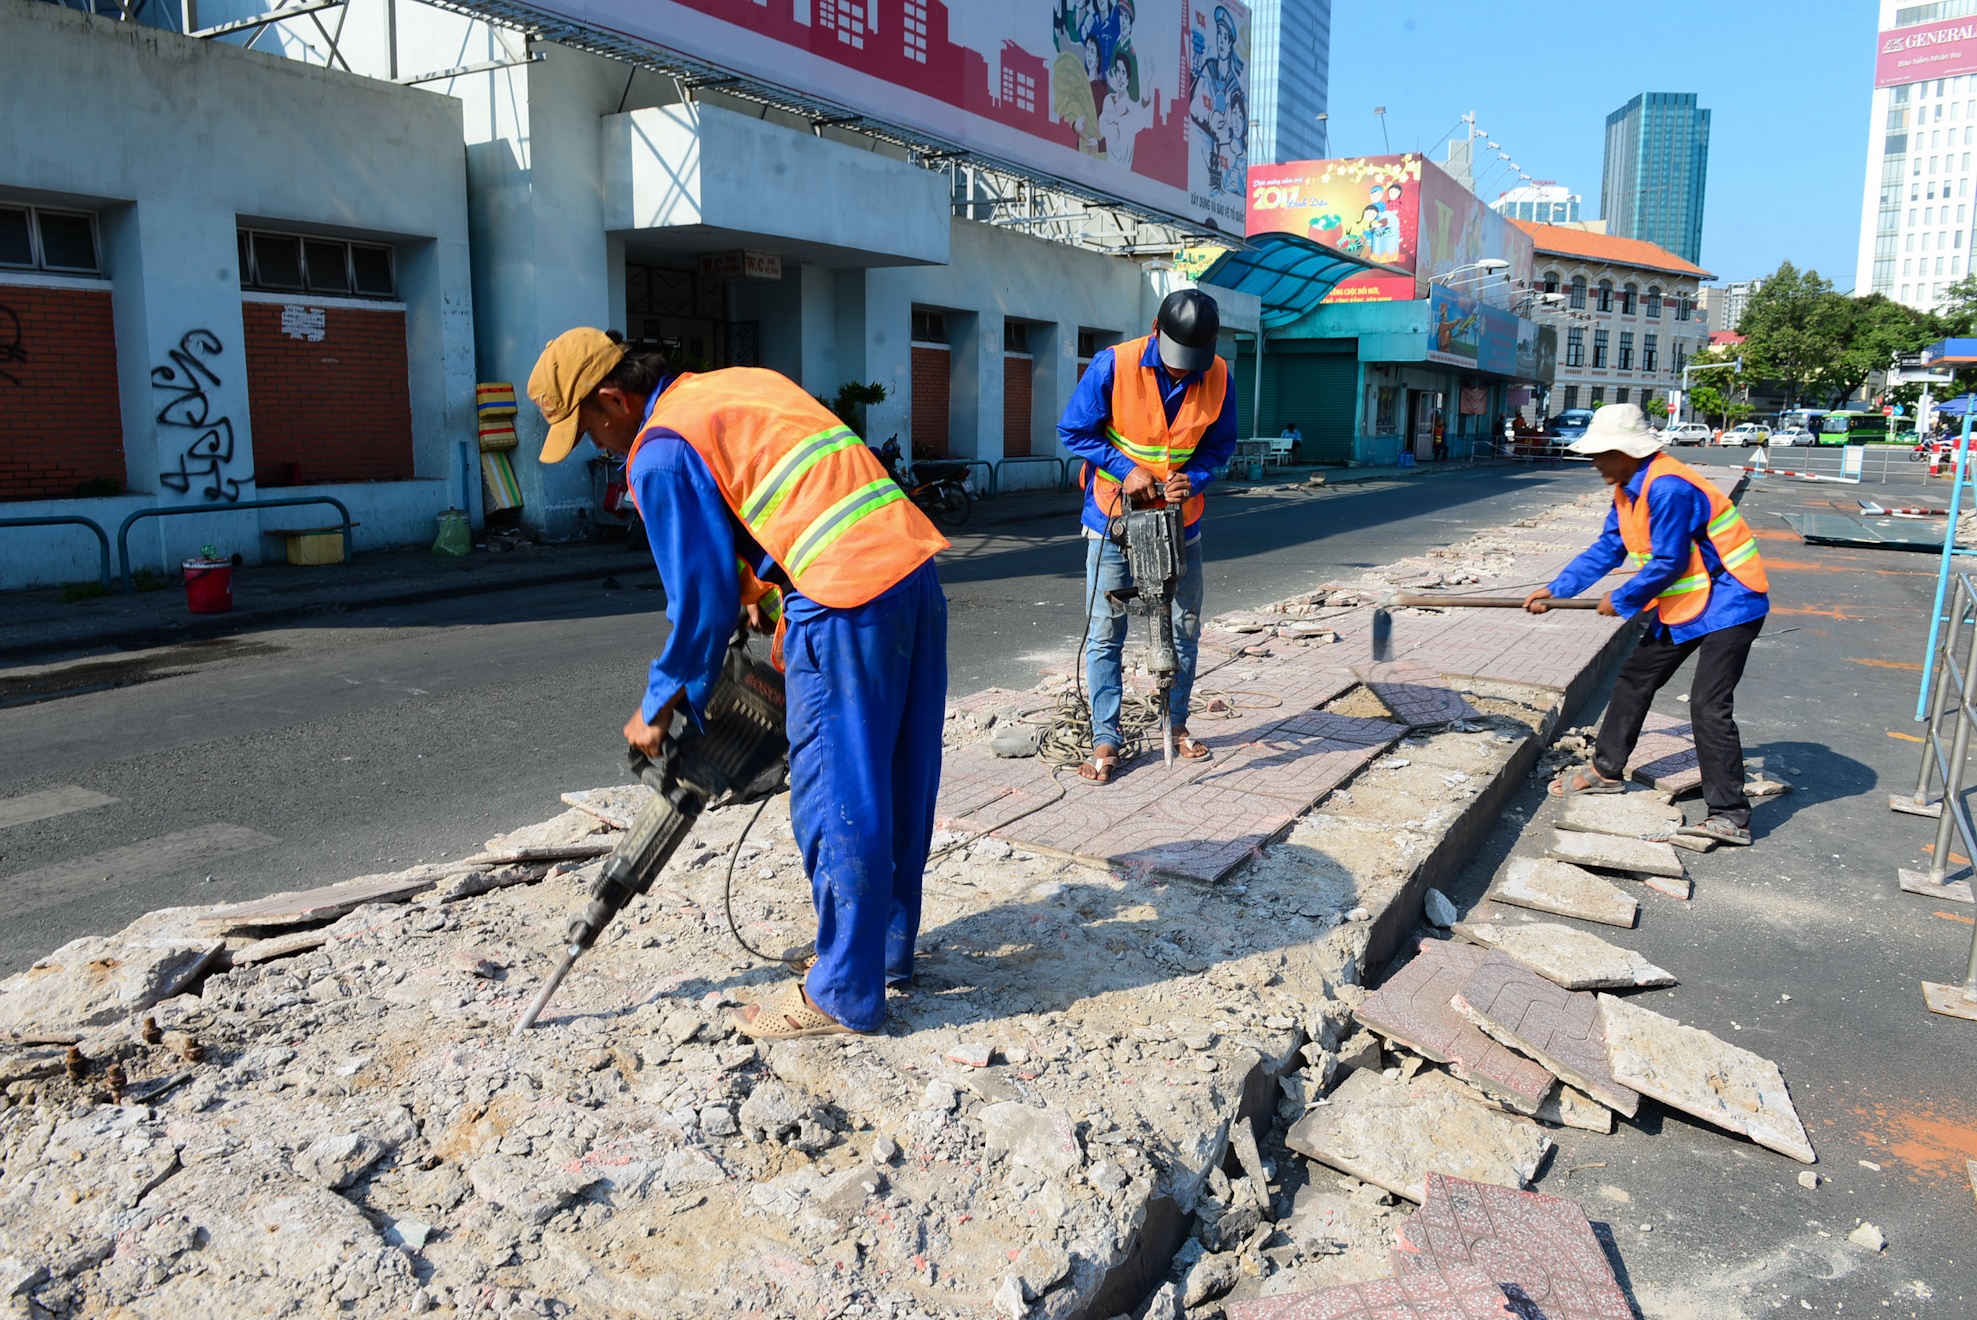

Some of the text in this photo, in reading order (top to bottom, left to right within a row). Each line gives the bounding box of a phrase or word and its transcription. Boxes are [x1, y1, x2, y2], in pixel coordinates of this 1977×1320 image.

[1905, 25, 1977, 48] GENERAL
[1253, 185, 1301, 211] 2017
[746, 256, 764, 272] W.C
